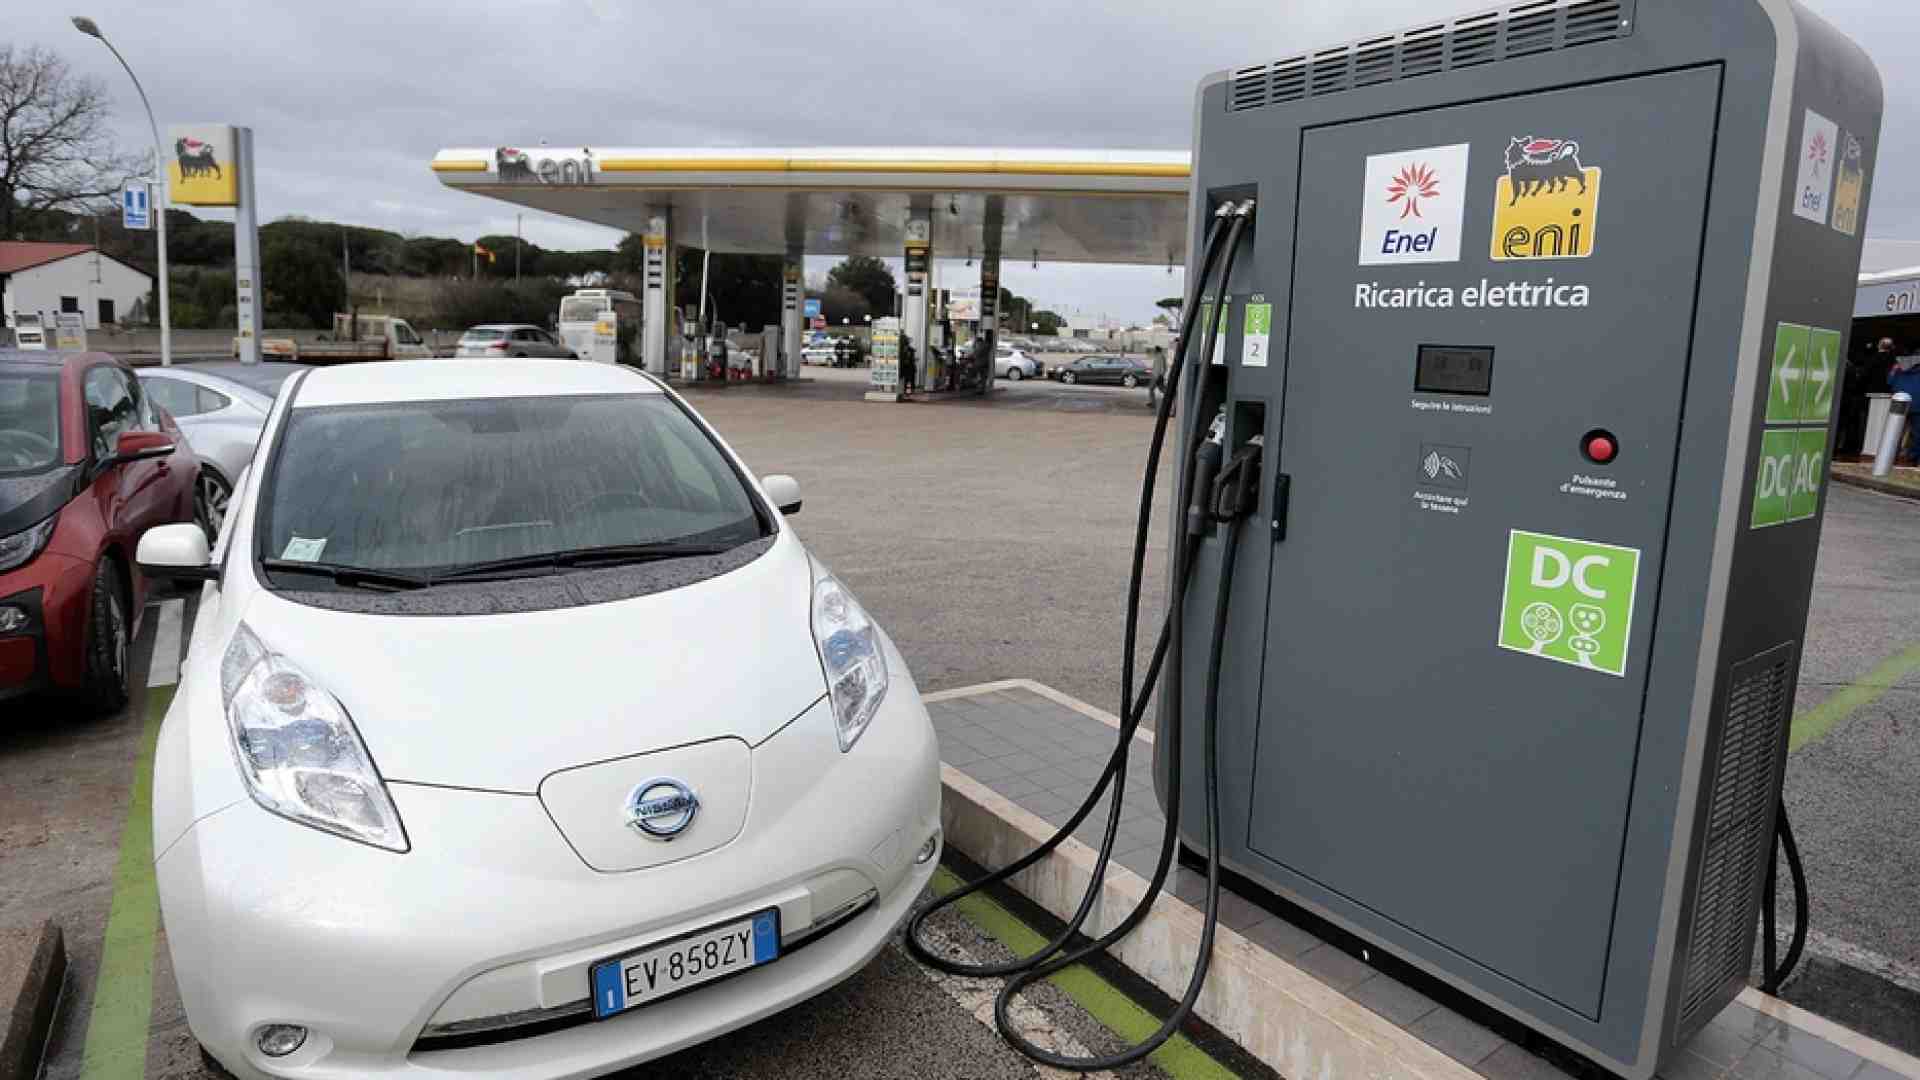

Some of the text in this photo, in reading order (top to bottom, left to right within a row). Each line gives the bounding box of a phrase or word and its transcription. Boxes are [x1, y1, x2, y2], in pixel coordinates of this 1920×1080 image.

[536, 144, 593, 185] eni
[1381, 226, 1438, 255] Enel
[1502, 207, 1583, 258] eni
[1354, 277, 1590, 308] Ricarica elettrica
[1886, 283, 1916, 312] eni
[1251, 343, 1260, 357] 2
[1759, 453, 1793, 498] DC
[1792, 451, 1823, 495] AC
[1530, 545, 1610, 600] DC
